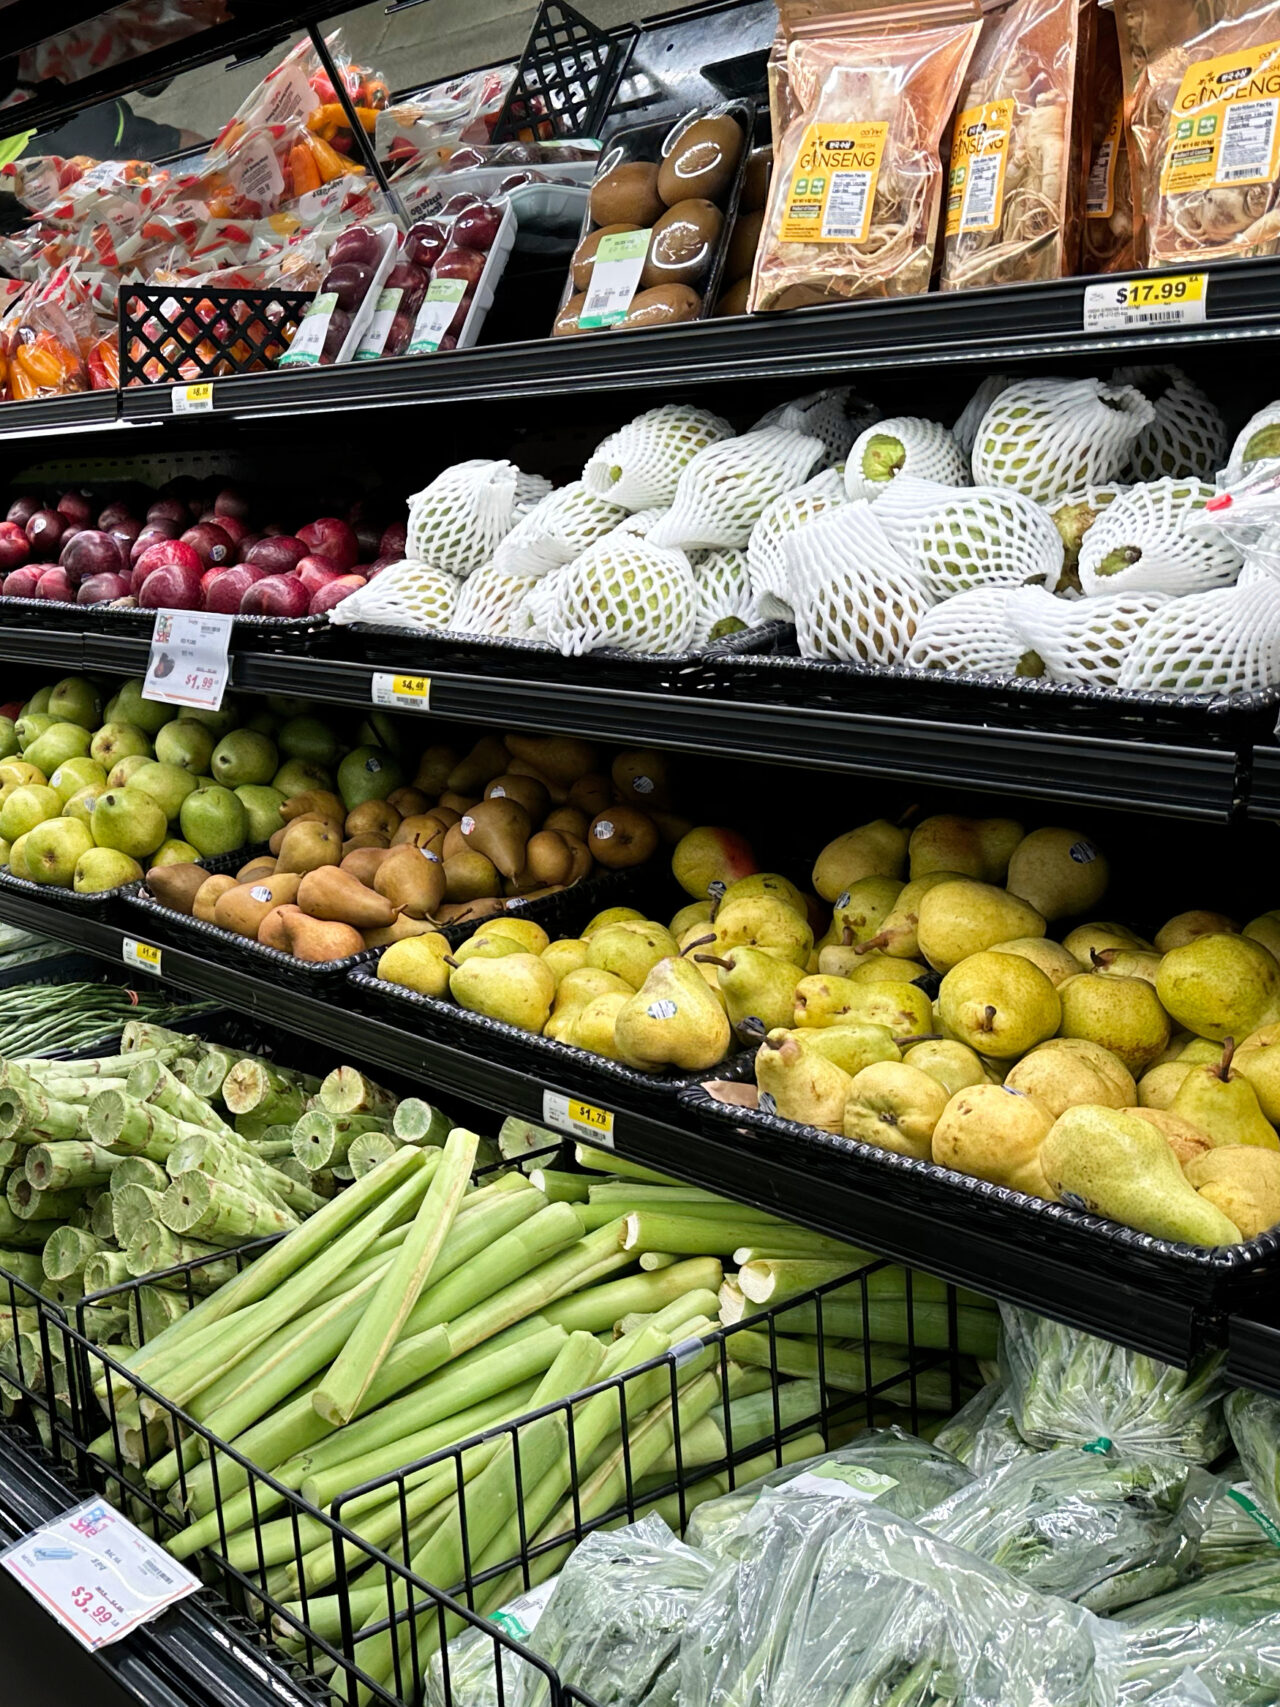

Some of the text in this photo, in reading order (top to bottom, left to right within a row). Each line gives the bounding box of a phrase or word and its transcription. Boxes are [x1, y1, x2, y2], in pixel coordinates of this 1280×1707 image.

[800, 151, 876, 169] GINSENG
[1116, 281, 1187, 304] $17.99
[71, 1585, 113, 1625] $3.99
